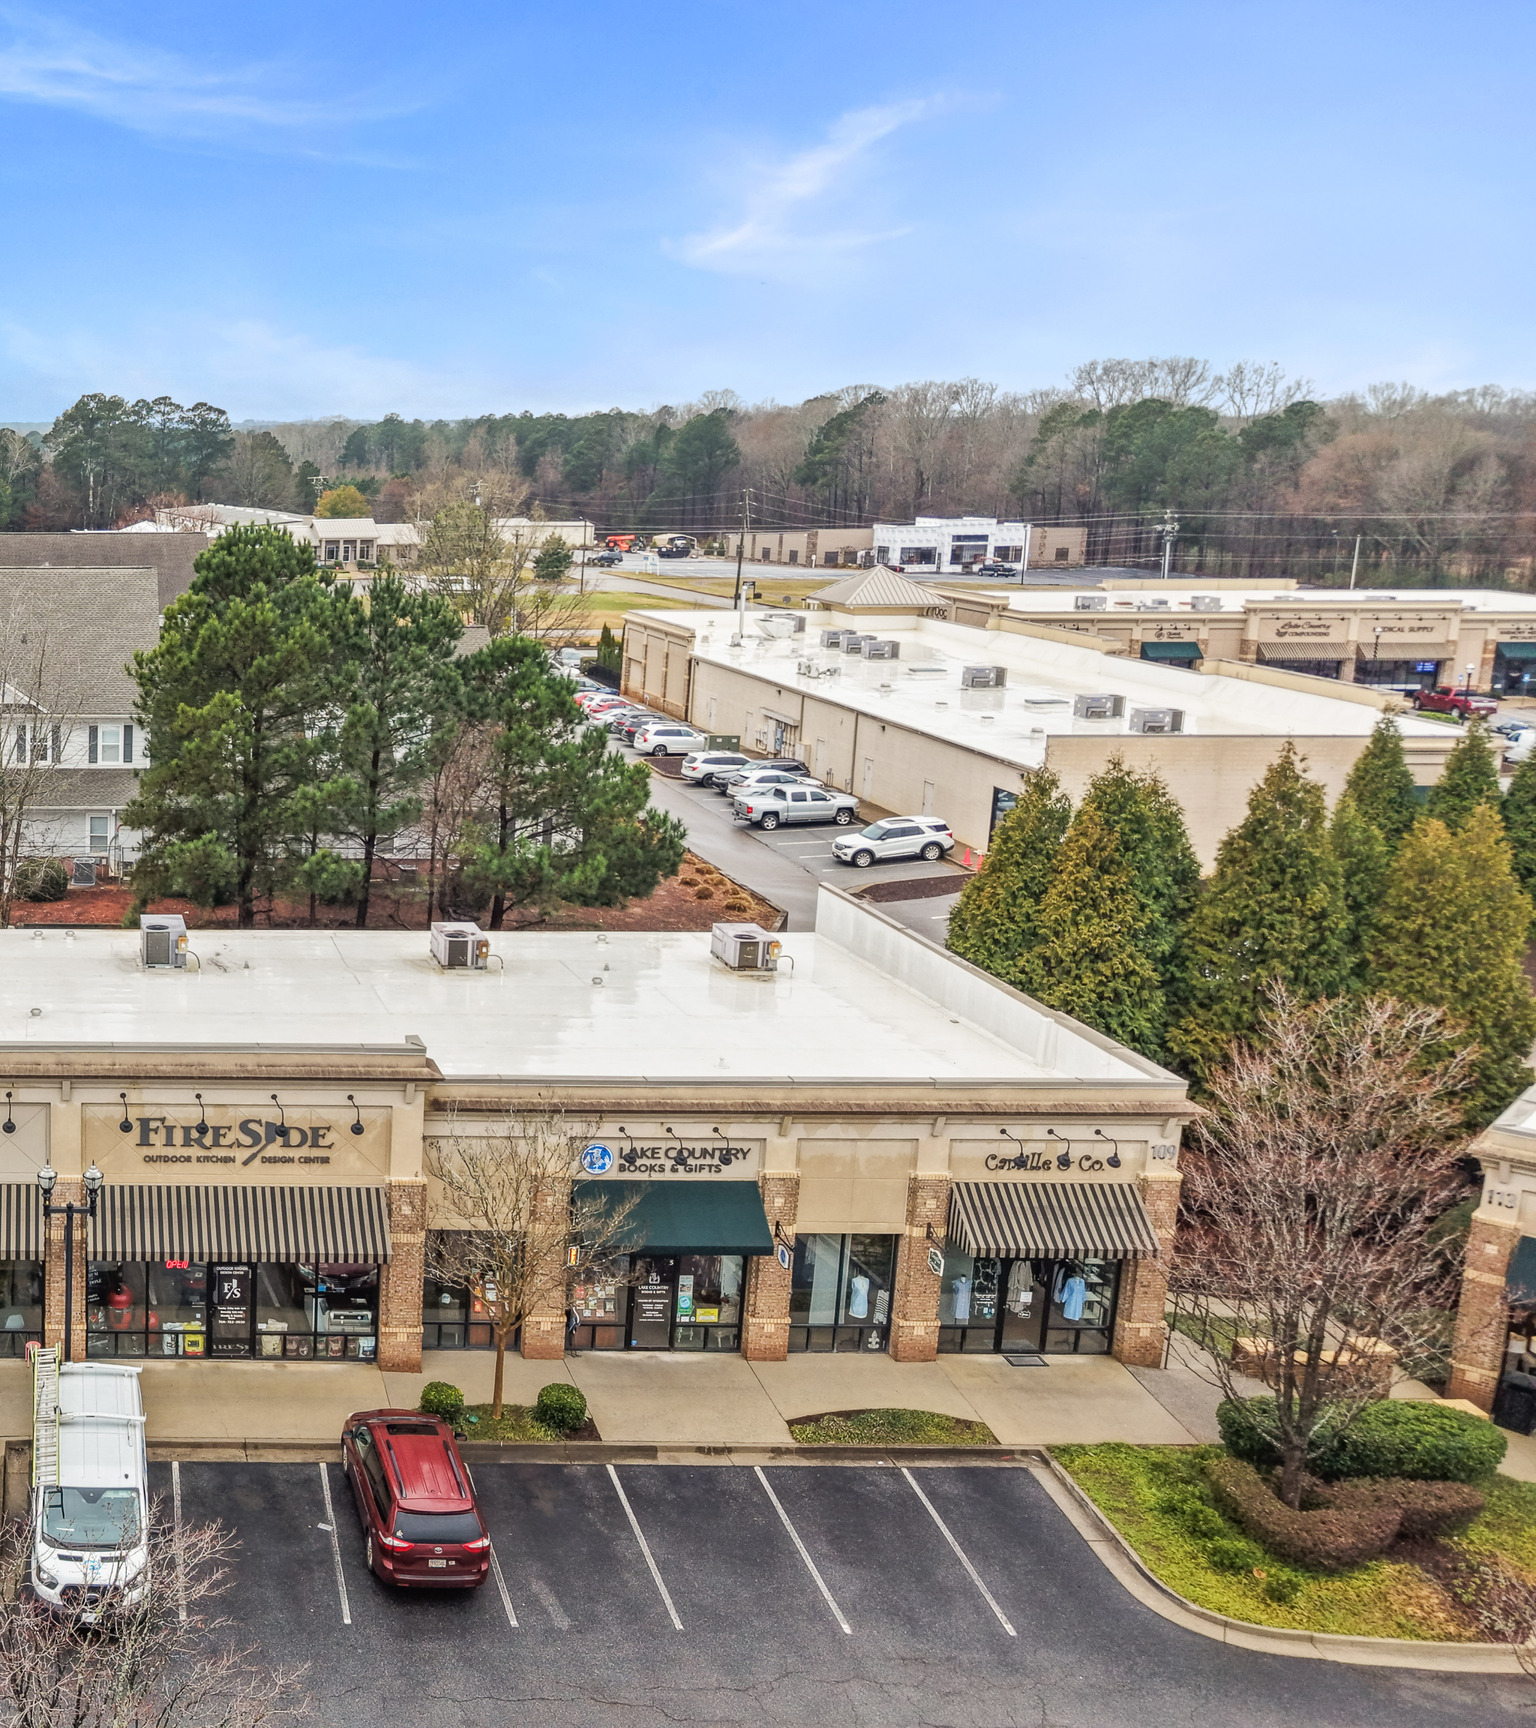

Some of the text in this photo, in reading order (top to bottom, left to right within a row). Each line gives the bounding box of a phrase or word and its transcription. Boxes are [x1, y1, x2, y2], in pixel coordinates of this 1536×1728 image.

[143, 1154, 331, 1165] OUTDOOR KITCHEN DESIGN CENTER
[619, 1146, 752, 1161] LAKE COUNTRY
[1150, 1144, 1178, 1161] 109
[618, 1163, 723, 1173] BOOKS & GIFTS
[1078, 1154, 1106, 1171] Co.
[1487, 1189, 1518, 1209] 113
[166, 1259, 189, 1270] OPEN
